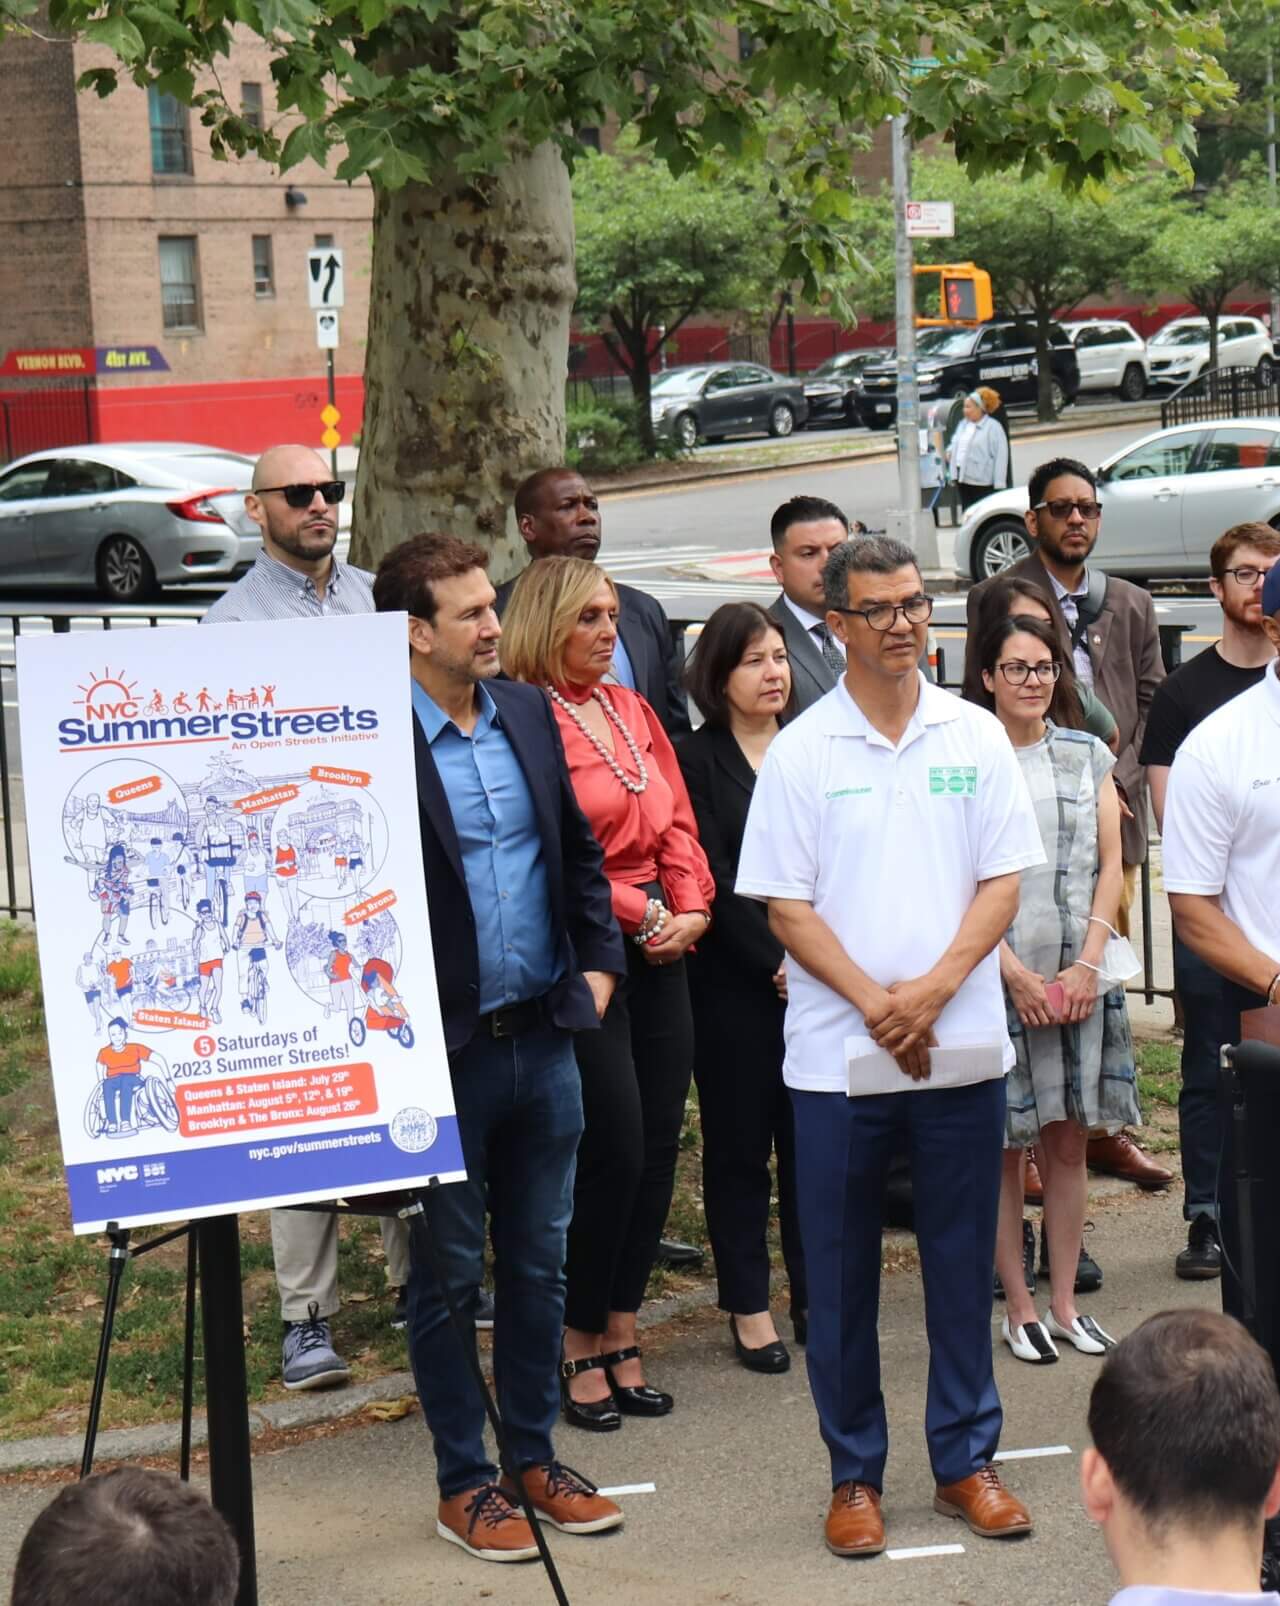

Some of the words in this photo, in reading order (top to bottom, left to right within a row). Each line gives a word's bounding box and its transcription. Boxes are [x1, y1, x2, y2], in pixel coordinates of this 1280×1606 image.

[16, 354, 55, 370] VERNON
[86, 702, 138, 720] NYC
[231, 741, 247, 751] An
[250, 739, 282, 751] Open
[285, 735, 328, 747] Streets
[330, 731, 379, 744] Initiative
[316, 768, 363, 784] Brooklyn
[115, 780, 154, 800] Queens
[241, 789, 296, 809] Manhattan
[138, 1011, 171, 1025] Staten
[173, 1016, 207, 1028] Island
[200, 1037, 210, 1054] 5
[217, 1029, 298, 1052] Saturdays
[303, 1026, 318, 1043] of
[172, 1060, 213, 1079] 2023
[216, 1053, 283, 1073] Summer
[288, 1043, 350, 1064] Streets!
[184, 1089, 223, 1102] Queens
[226, 1086, 234, 1096] &
[236, 1083, 270, 1095] Staten
[272, 1078, 307, 1090] Island:
[309, 1074, 331, 1087] July
[186, 1101, 246, 1117] Manhattan:
[248, 1093, 284, 1109] August
[325, 1087, 334, 1099] &
[188, 1115, 236, 1132] Brooklyn
[238, 1113, 246, 1124] &
[249, 1111, 268, 1123] The
[270, 1108, 304, 1120] Bronx:
[306, 1103, 341, 1118] August
[248, 1131, 382, 1160] nyc.gov/summerstreets
[97, 1165, 139, 1184] NYC
